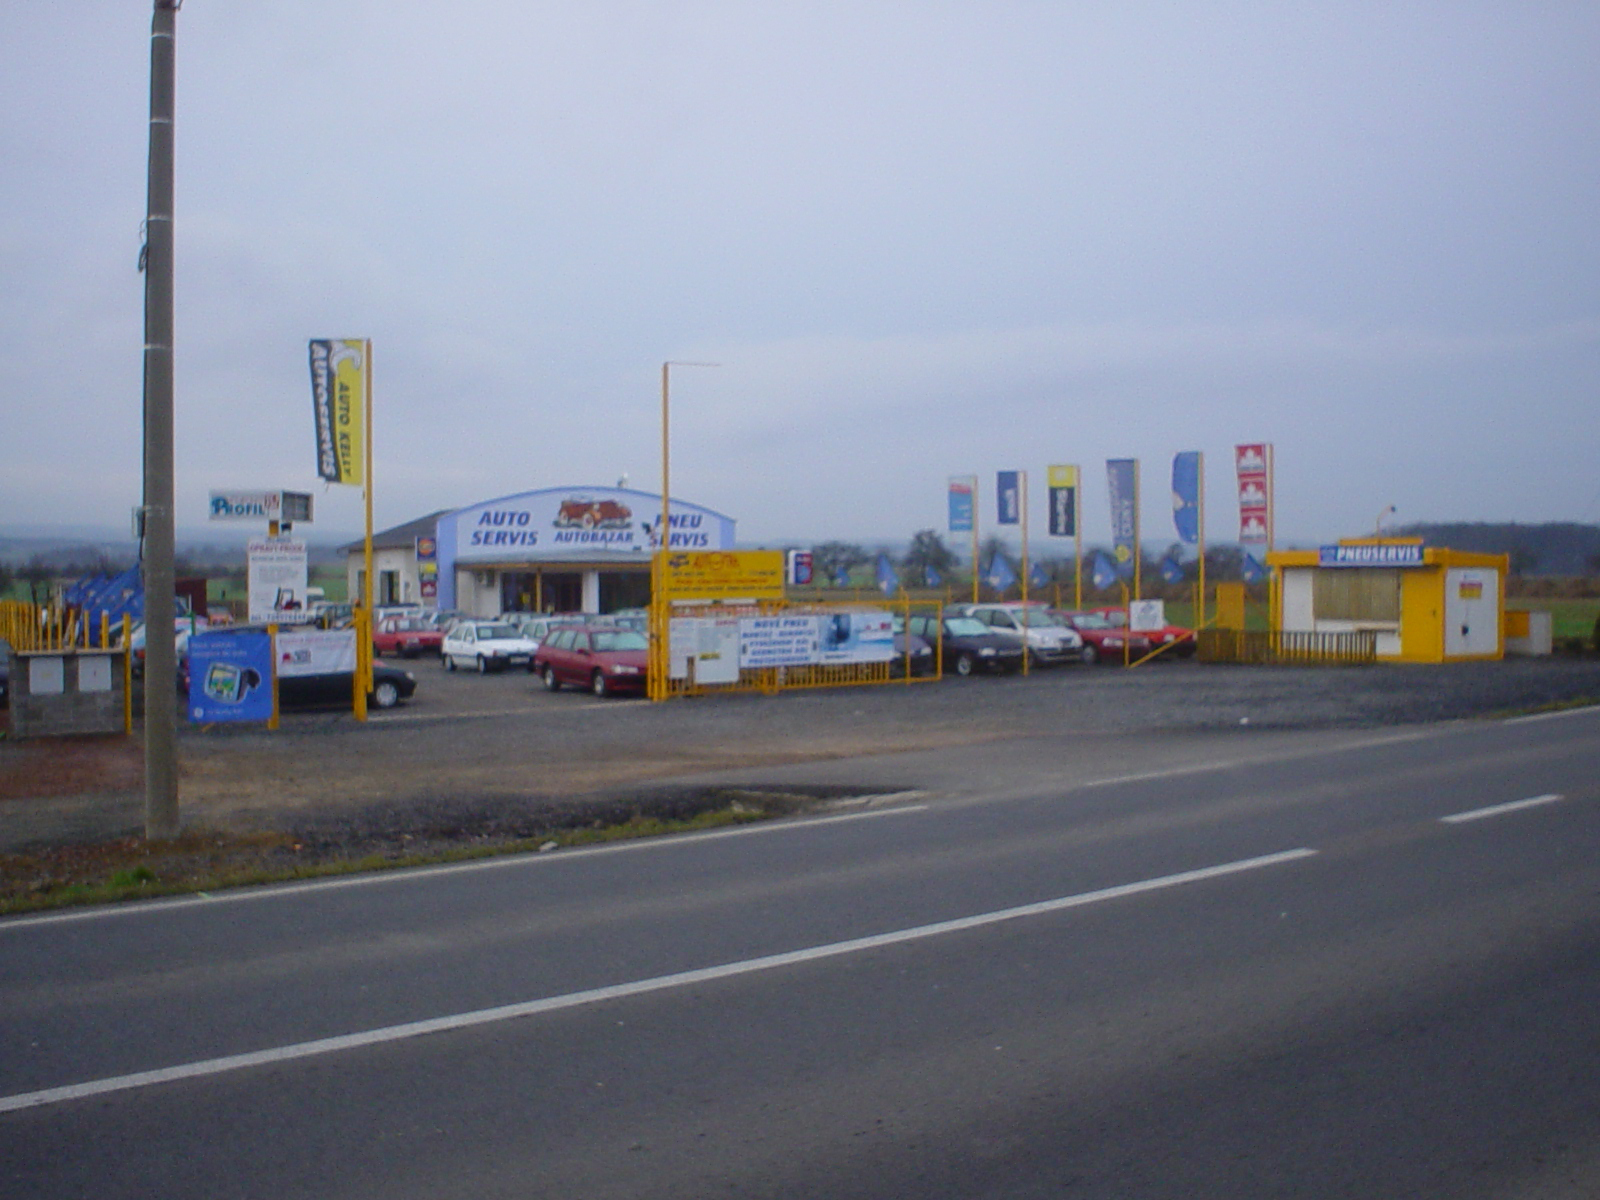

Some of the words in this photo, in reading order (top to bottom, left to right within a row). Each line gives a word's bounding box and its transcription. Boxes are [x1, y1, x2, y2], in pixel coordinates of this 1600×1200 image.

[338, 381, 351, 426] AUTO
[339, 432, 352, 477] KELLY
[478, 511, 531, 526] AUTO
[470, 530, 538, 546] SERVIS
[554, 530, 635, 544] AUTOBAZAR
[1337, 546, 1420, 562] PNEUSERVIS
